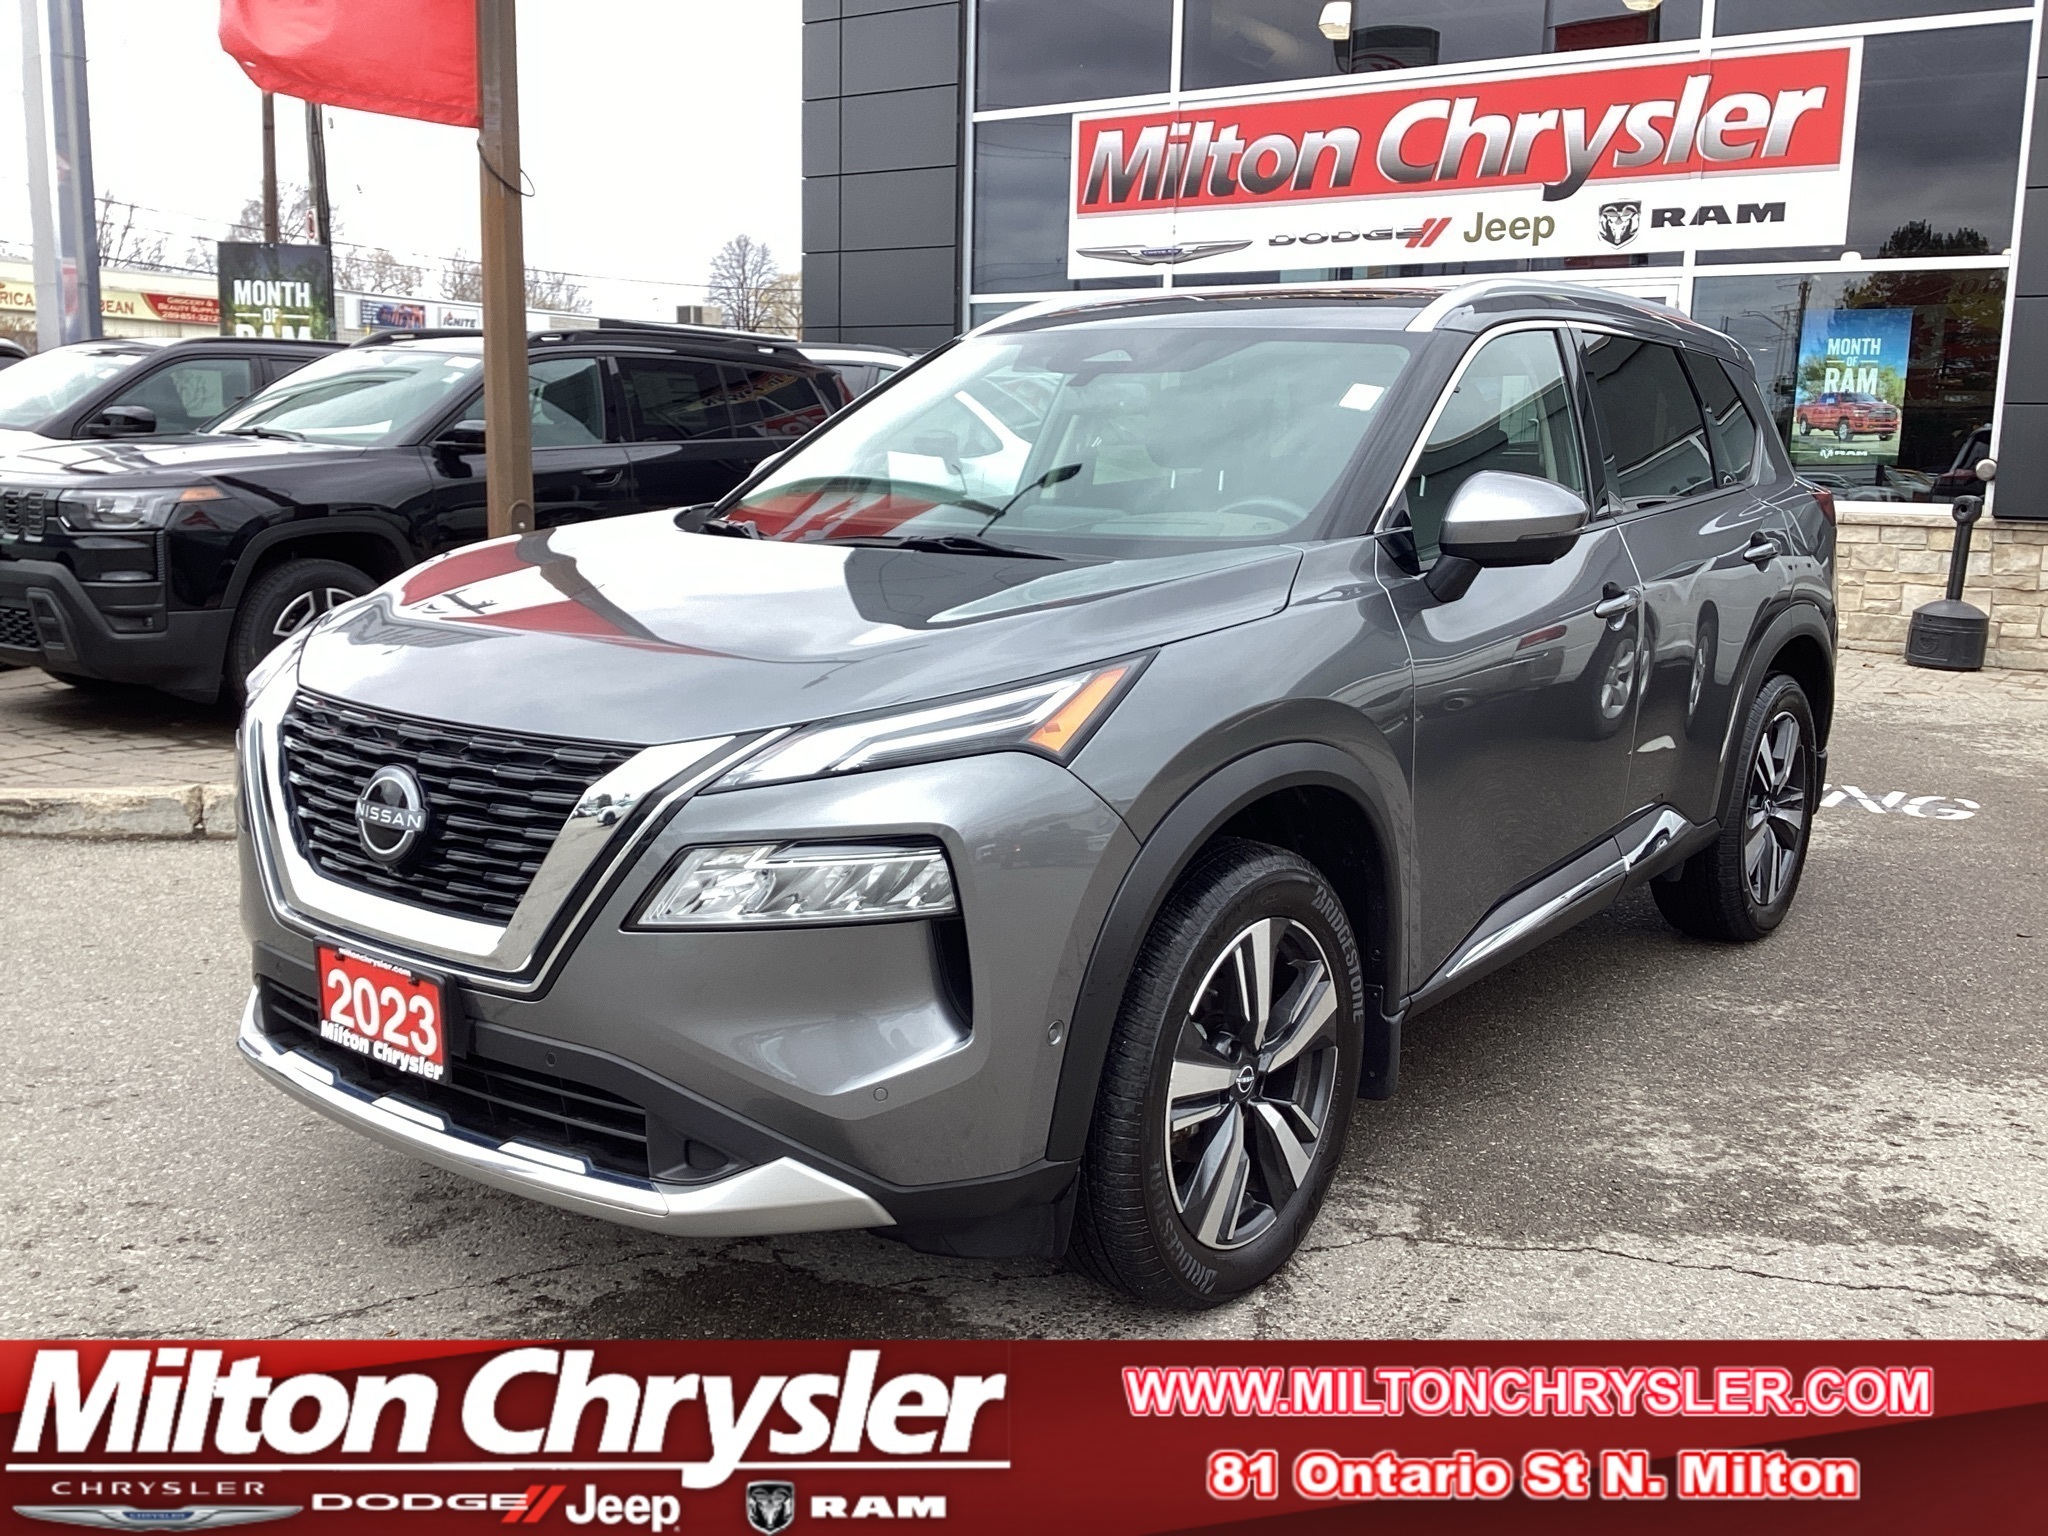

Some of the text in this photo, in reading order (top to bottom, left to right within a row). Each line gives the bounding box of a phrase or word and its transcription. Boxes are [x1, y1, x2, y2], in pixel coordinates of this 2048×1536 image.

[1081, 74, 1829, 205] Milton Chrysler
[1651, 201, 1786, 228] RAM
[1268, 227, 1425, 246] DODGE
[1463, 212, 1556, 246] Jeep
[233, 279, 310, 307] MONTH
[263, 308, 280, 323] OF
[1827, 338, 1881, 355] MONTH
[1846, 356, 1858, 367] OF
[1823, 367, 1879, 395] RAM
[357, 800, 422, 829] NISSAN
[1311, 884, 1364, 1024] BRIDGESTONE
[327, 968, 437, 1056] 2023
[321, 1019, 444, 1081] Milton Chrysler
